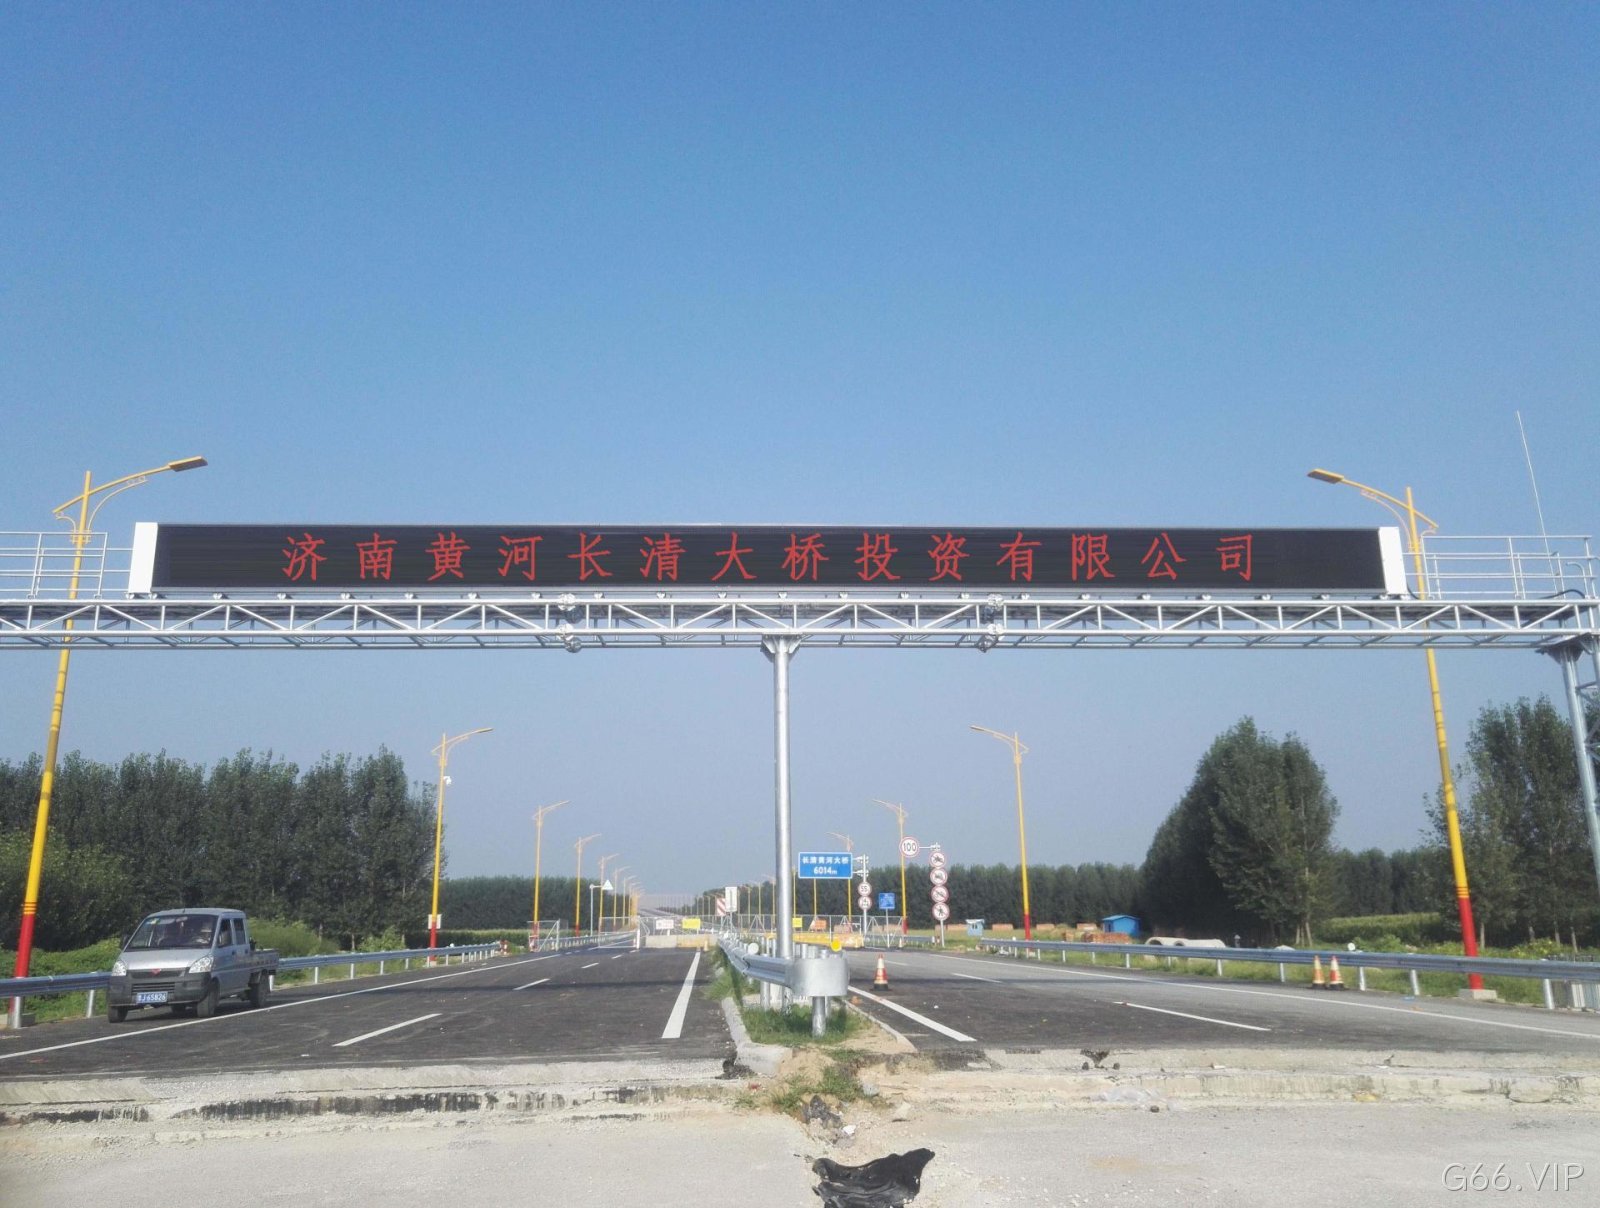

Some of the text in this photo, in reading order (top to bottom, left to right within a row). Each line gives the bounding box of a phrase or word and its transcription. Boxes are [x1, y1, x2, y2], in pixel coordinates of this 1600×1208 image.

[282, 532, 1253, 581] 济南黄河长清大桥投资有限公司
[903, 842, 917, 852] 100
[802, 856, 849, 865] 长清黄河大桥
[813, 866, 838, 875] 6014m
